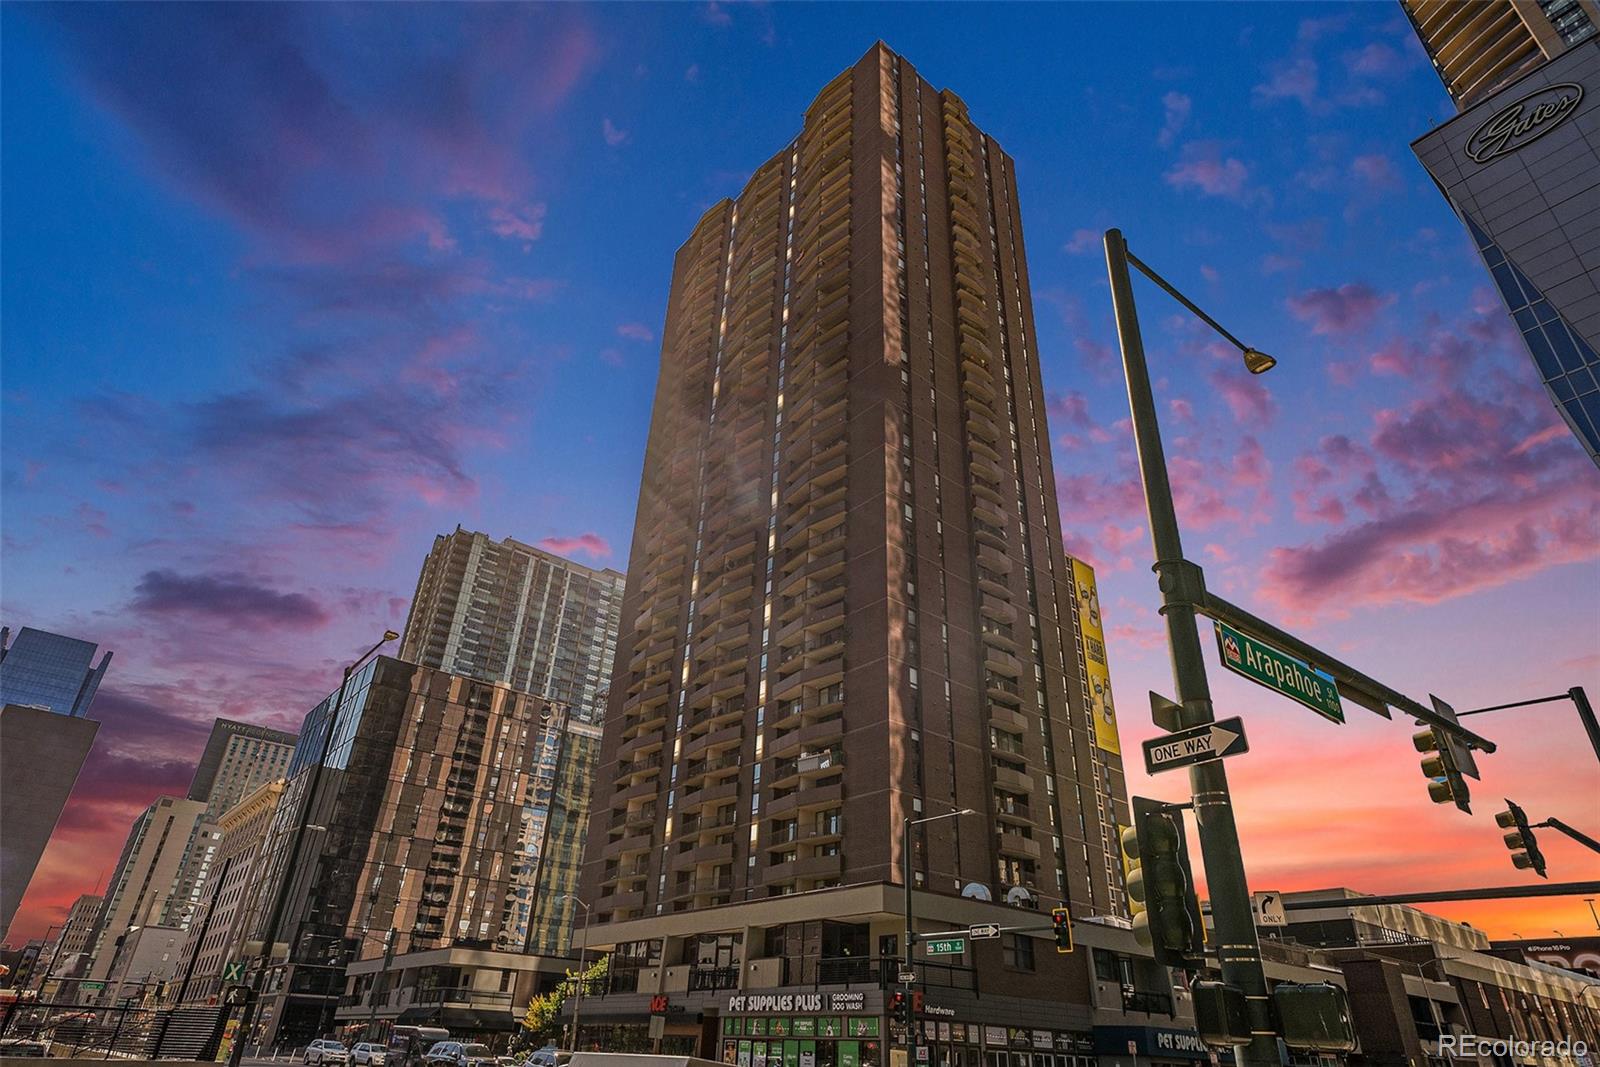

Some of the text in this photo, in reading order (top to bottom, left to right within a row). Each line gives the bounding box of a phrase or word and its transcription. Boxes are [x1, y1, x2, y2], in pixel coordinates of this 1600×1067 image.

[1474, 96, 1570, 162] Gates
[1245, 641, 1323, 703] Arapahoe
[1154, 735, 1211, 761] ONE WAY
[1262, 914, 1282, 923] ONLY
[936, 942, 952, 952] 15th
[729, 993, 822, 1012] PET SUPPLIES PLUS
[831, 992, 864, 1002] GROOMING
[831, 1002, 863, 1011] DOG WASH
[924, 1004, 956, 1017] Hardware
[1157, 1032, 1174, 1049] PET
